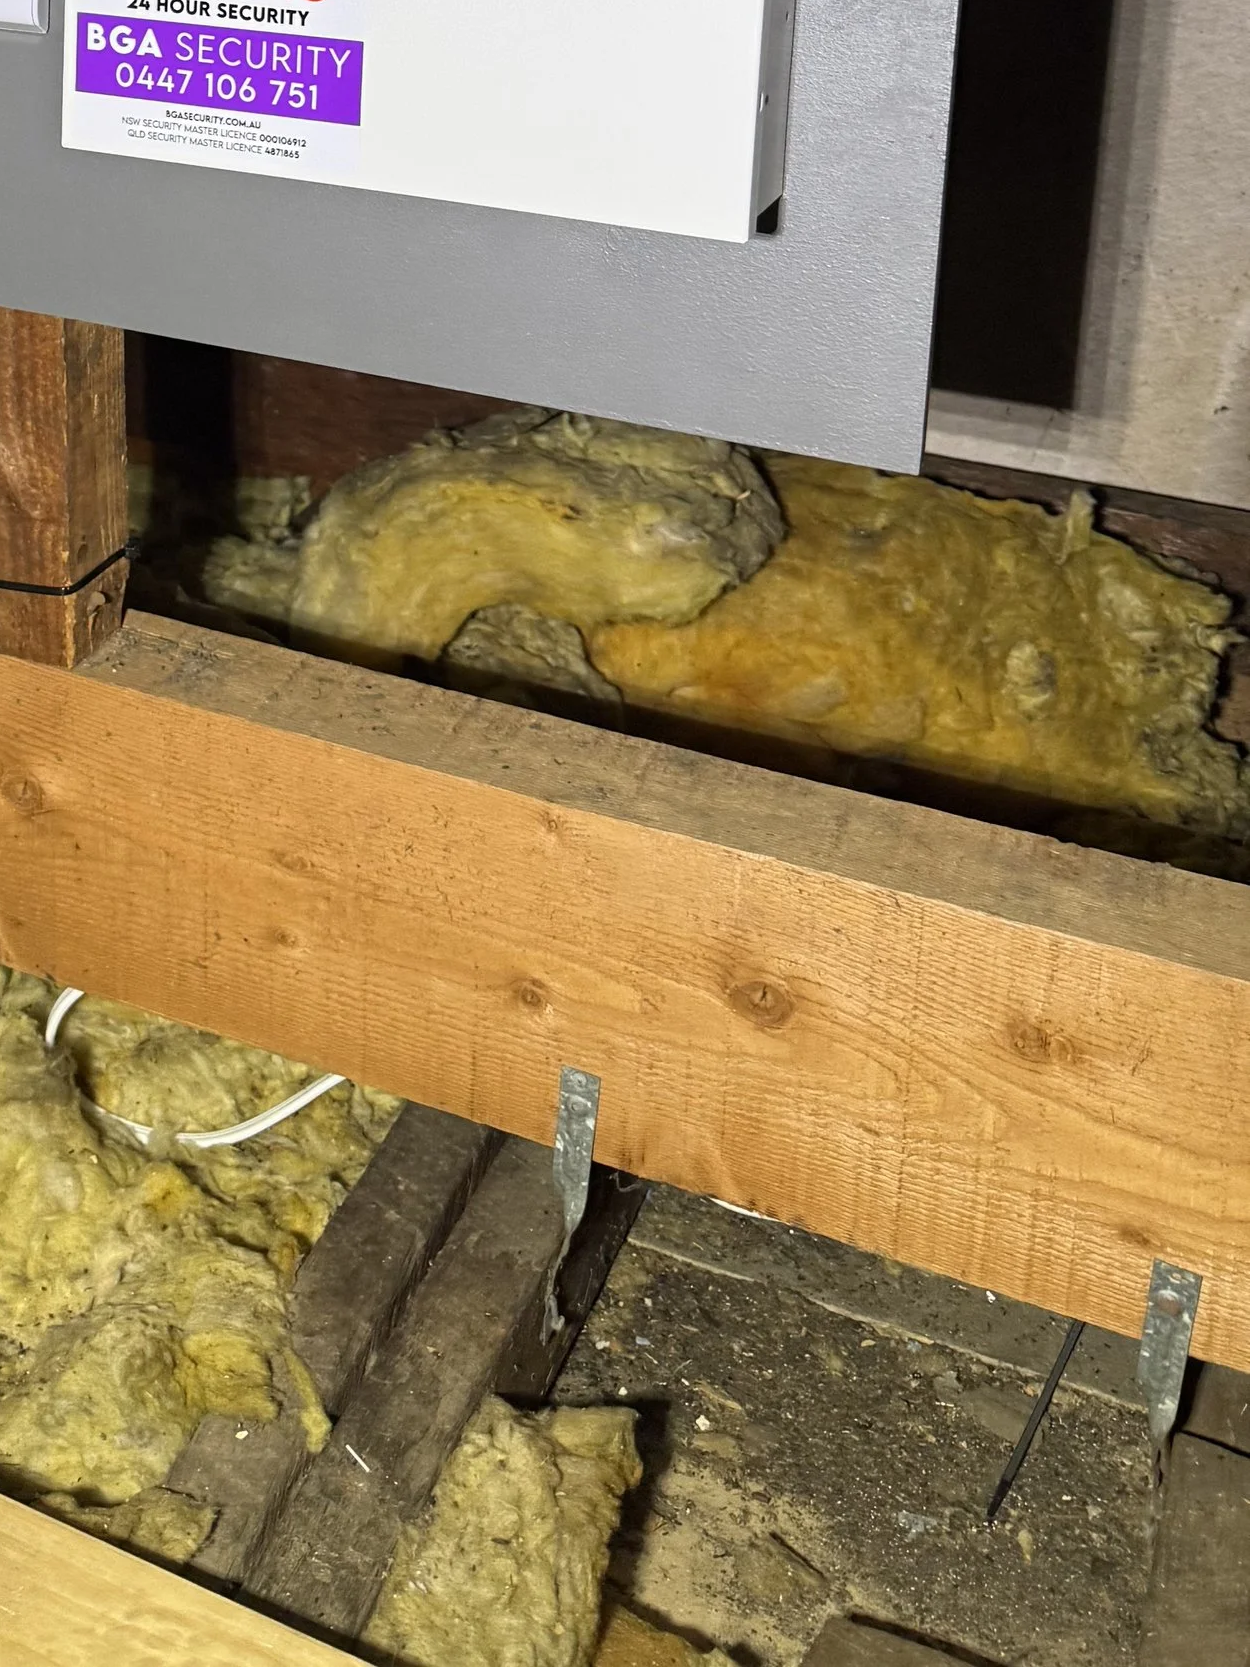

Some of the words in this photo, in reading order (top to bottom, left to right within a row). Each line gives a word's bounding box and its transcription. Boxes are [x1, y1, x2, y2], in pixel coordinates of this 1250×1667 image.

[217, 3, 310, 27] SECURITY
[86, 23, 163, 58] BGA
[175, 32, 352, 79] SECURITY
[115, 62, 193, 95] 0447
[205, 72, 257, 103] 106
[270, 80, 318, 110] 751
[121, 116, 141, 127] NSW
[142, 119, 183, 134] SECURITY
[184, 125, 219, 139] MASTER
[220, 129, 257, 142] LICENCE
[259, 134, 307, 148] 000106912
[166, 109, 262, 129] BGASECURITY.COM.AU
[127, 130, 145, 139] QLD
[147, 131, 188, 147] SECURITY
[189, 138, 224, 150] MASTER
[226, 142, 263, 155] LICENCE
[264, 147, 300, 159] 4871865
